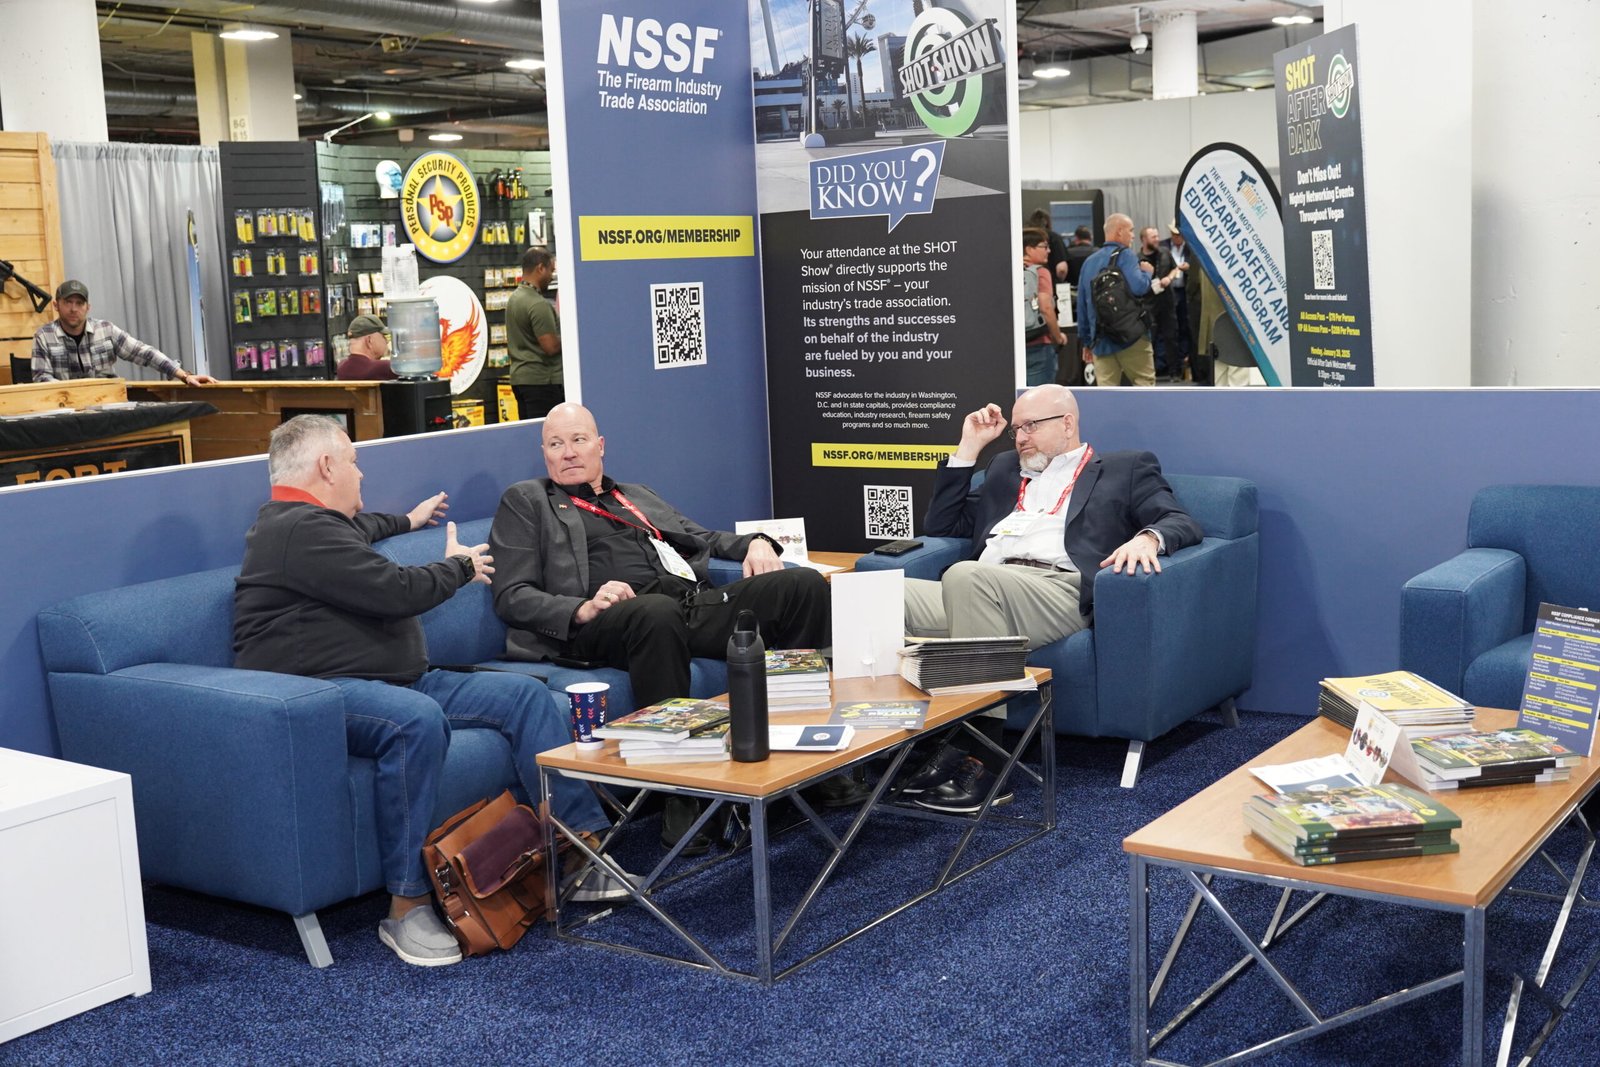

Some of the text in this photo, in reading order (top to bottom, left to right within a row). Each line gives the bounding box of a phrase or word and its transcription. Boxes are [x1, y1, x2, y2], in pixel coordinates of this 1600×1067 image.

[900, 24, 996, 94] SHOT SHOW
[1285, 54, 1315, 92] SHOT
[597, 70, 722, 100] The Firearm Industry
[598, 91, 708, 115] Trade Association
[1286, 84, 1327, 124] AFTER
[1287, 119, 1322, 156] DARK
[816, 160, 906, 184] DID YOU
[1297, 162, 1342, 186] Don't Miss Out!
[405, 159, 476, 235] PERSONAL SECURITY PRODUCTS
[817, 180, 908, 210] KNOW
[1209, 166, 1220, 181] THE
[1218, 181, 1241, 214] NATION'S
[1238, 212, 1256, 236] MOST
[1306, 187, 1335, 203] Networking
[1334, 185, 1354, 200] Events
[429, 194, 454, 227] PSP
[1299, 206, 1344, 225] Throughout Vegas
[598, 229, 741, 245] NSSF.ORG/MEMBERSHIP
[800, 240, 958, 260] Your attendance at the SHOT
[1196, 173, 1242, 240] FIREARM
[1236, 237, 1277, 296] SAFETY
[1269, 297, 1289, 331] AND
[835, 262, 875, 276] directly
[877, 261, 926, 276] supports
[929, 259, 948, 271] the
[1184, 186, 1283, 345] EDUCATION PROGRAM
[802, 281, 841, 294] mission
[843, 280, 855, 292] of
[903, 280, 930, 293] your
[802, 295, 951, 312] industry's trade association.
[803, 314, 957, 329] Its strengths and successes
[804, 331, 940, 344] on behalf of the industry
[805, 348, 953, 363] are fueled by you and your
[805, 366, 856, 378] business.
[886, 392, 910, 400] industry
[918, 392, 957, 400] Washington,
[932, 412, 951, 420] safety
[823, 450, 950, 462] NSSF.ORG/MEMBERSHIP
